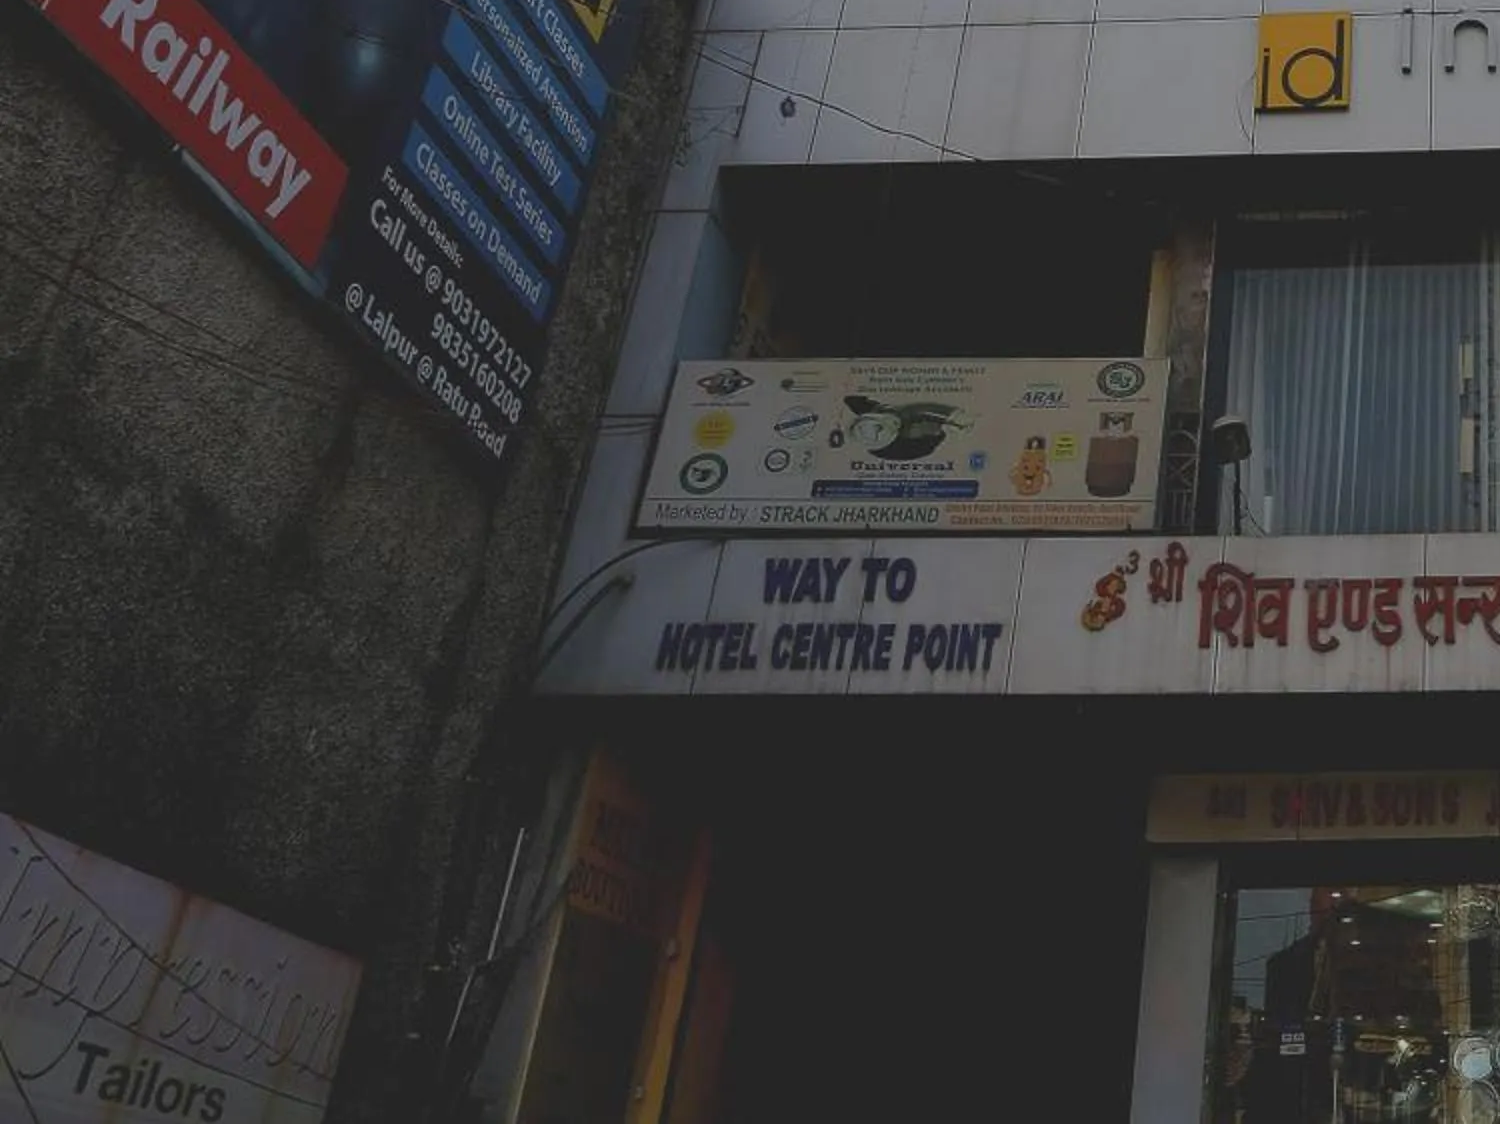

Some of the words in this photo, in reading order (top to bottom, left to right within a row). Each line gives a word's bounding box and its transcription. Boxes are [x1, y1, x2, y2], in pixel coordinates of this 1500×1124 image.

[543, 9, 586, 78] Classes
[1262, 19, 1346, 109] id
[443, 95, 491, 166] Online
[490, 149, 519, 199] Test
[515, 187, 553, 245] Series
[470, 51, 521, 129] Library
[516, 117, 562, 188] Facility
[416, 142, 468, 218] Classes
[467, 209, 488, 242] on
[487, 228, 543, 306] Demand
[344, 282, 364, 313] @
[362, 293, 420, 366] Lalpur
[415, 354, 433, 384] @
[431, 364, 470, 418] Ratu
[370, 198, 406, 253] Call
[402, 238, 427, 276] us
[424, 264, 443, 294] @
[440, 278, 532, 390] 9031972127
[430, 311, 523, 425] 9835160208
[655, 503, 729, 521] Marketed
[759, 505, 831, 524] STRACK
[832, 505, 940, 524] JHARKHAND
[763, 557, 852, 604] WAY
[860, 557, 917, 603] TO
[1147, 541, 1189, 604] श्री
[1197, 561, 1294, 648] शिव
[1304, 575, 1403, 653] एण्ड
[655, 622, 758, 672] HOTEL
[770, 622, 892, 672] CENTRE
[902, 622, 1003, 672] POINT
[72, 1040, 228, 1124] Tailors
